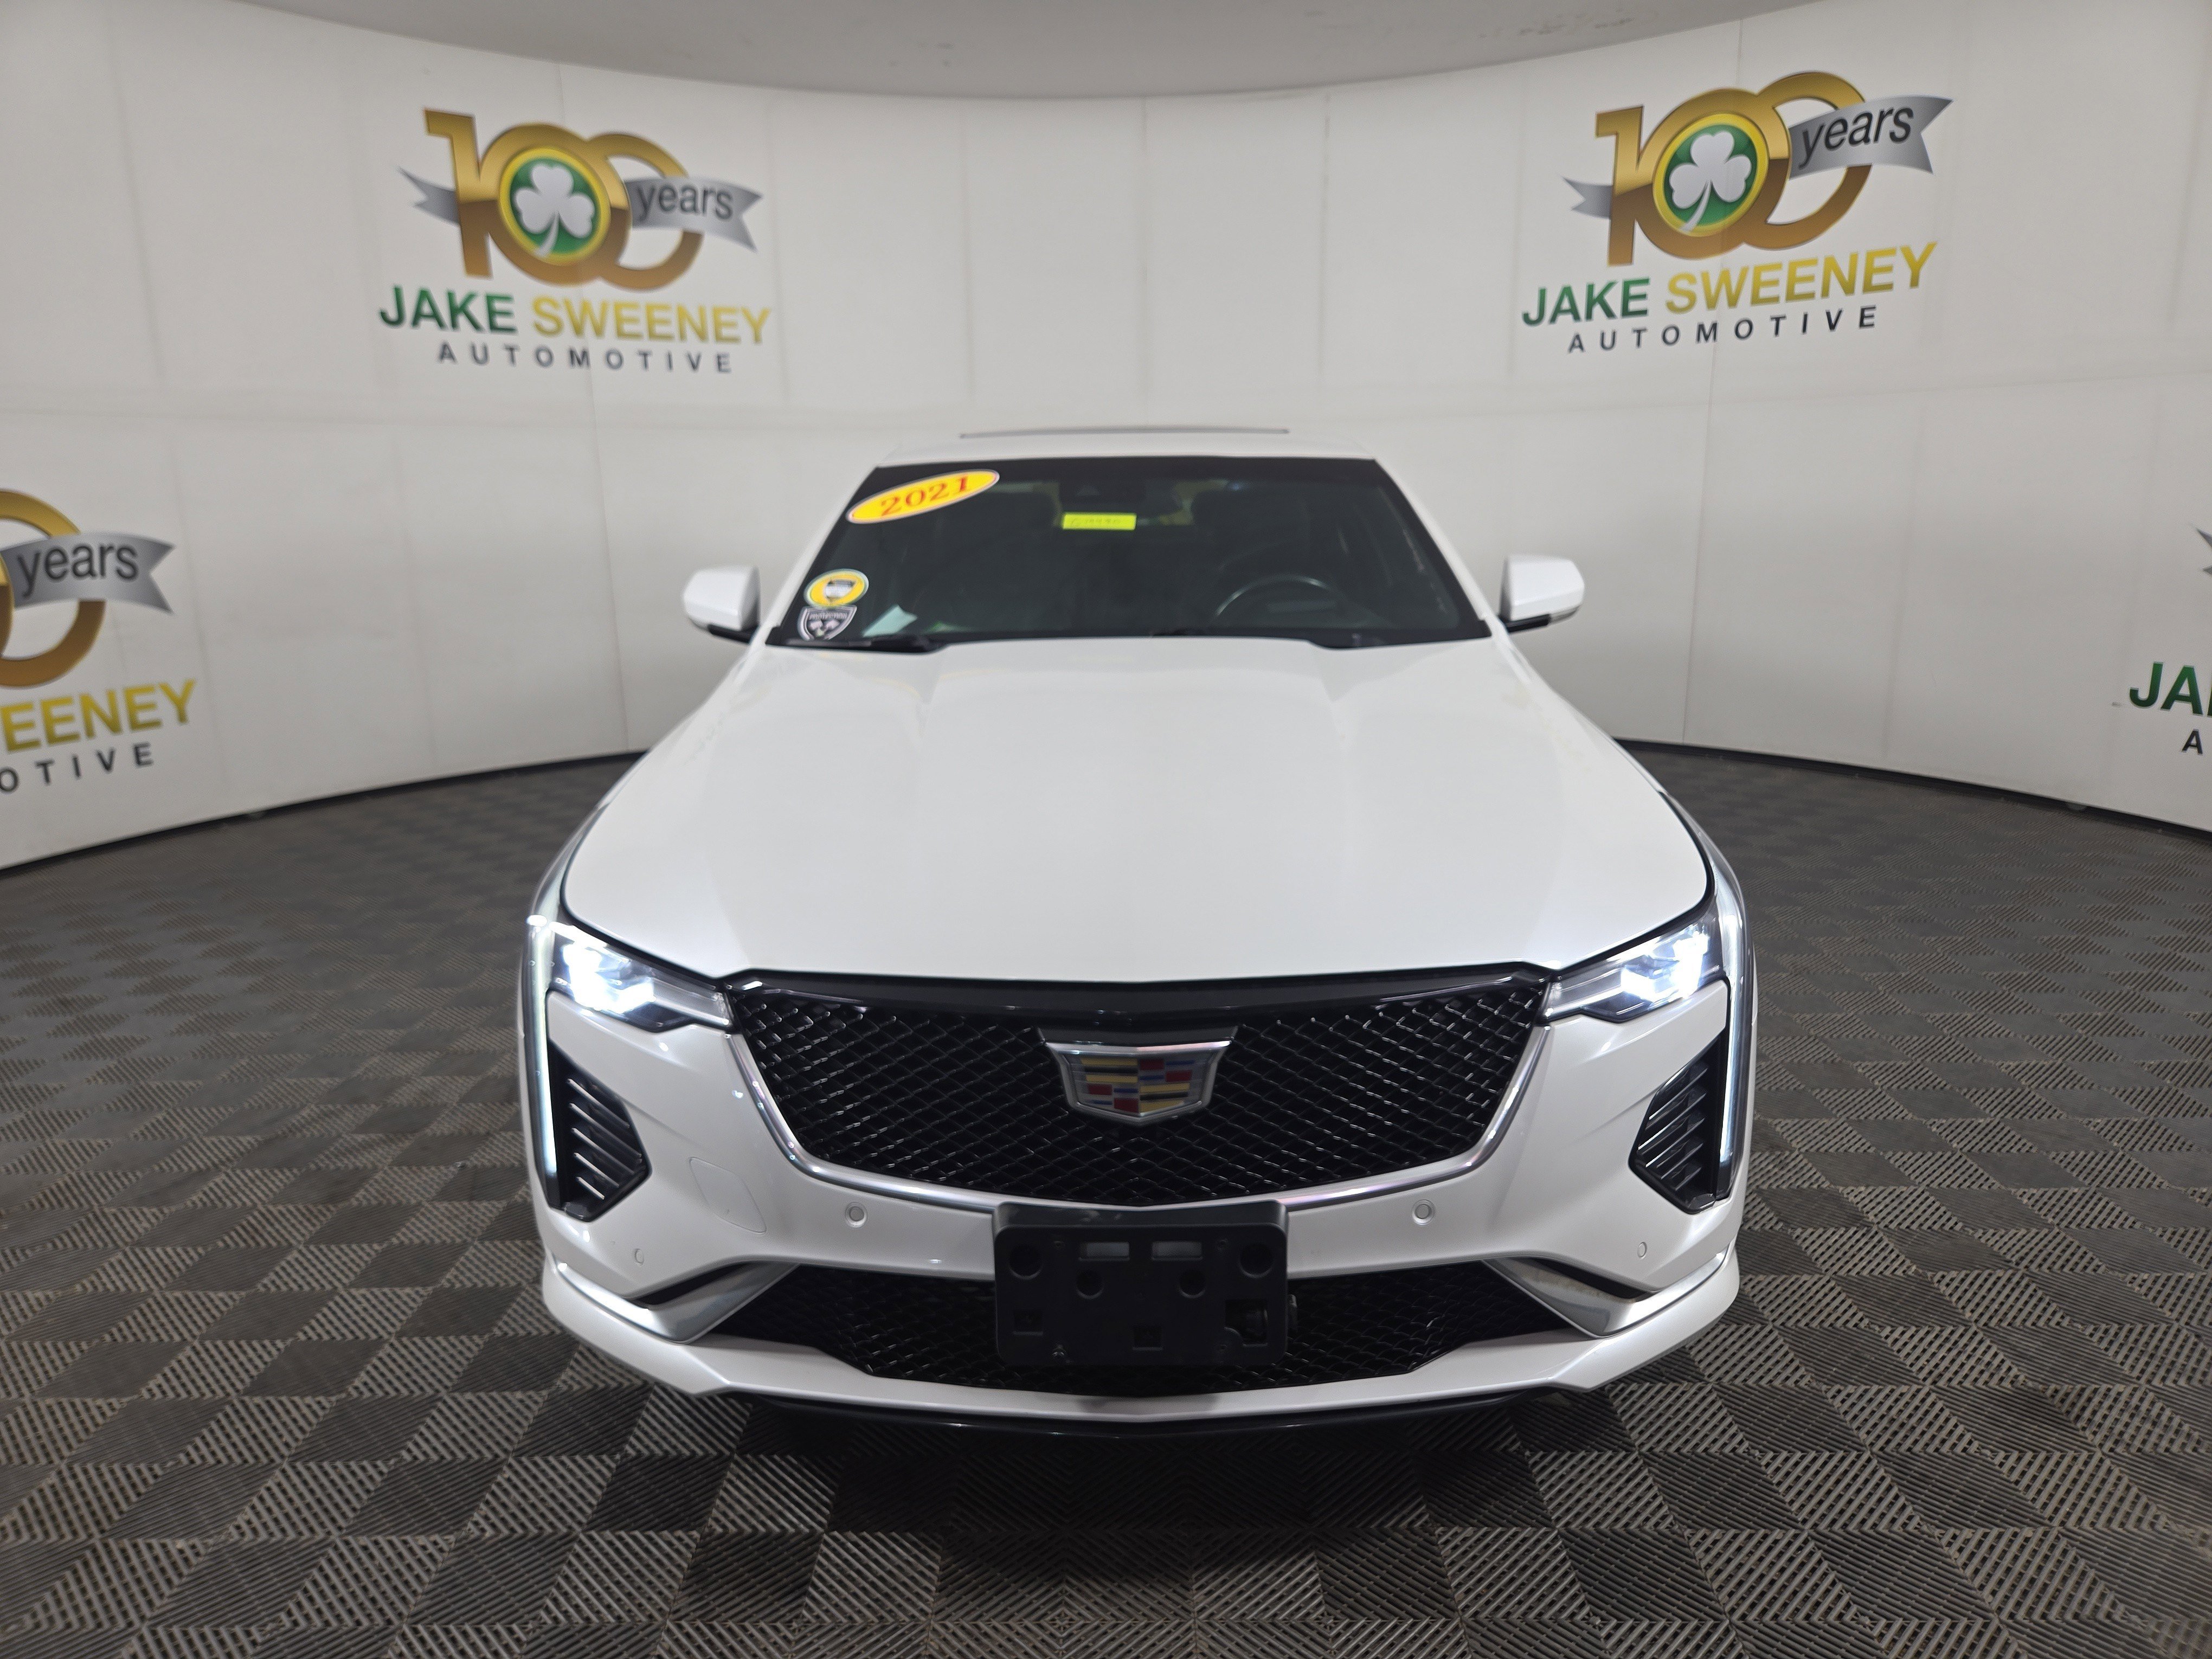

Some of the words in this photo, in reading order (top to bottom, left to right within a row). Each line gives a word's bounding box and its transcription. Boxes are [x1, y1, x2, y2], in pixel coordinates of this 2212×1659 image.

[1596, 70, 1873, 266] 100
[1798, 106, 1914, 169] years
[424, 108, 704, 293] 100
[636, 183, 734, 222] years
[1521, 277, 1650, 327] JAKE
[1666, 241, 1937, 314] SWEENEY
[380, 285, 519, 334] JAKE
[531, 294, 771, 345] SWEENEY
[1567, 305, 1877, 353] AUTOMOTIVE
[438, 340, 733, 373] AUTOMOTIVE
[880, 475, 969, 517] 2021
[17, 543, 139, 597] years
[2129, 661, 2212, 717] JA
